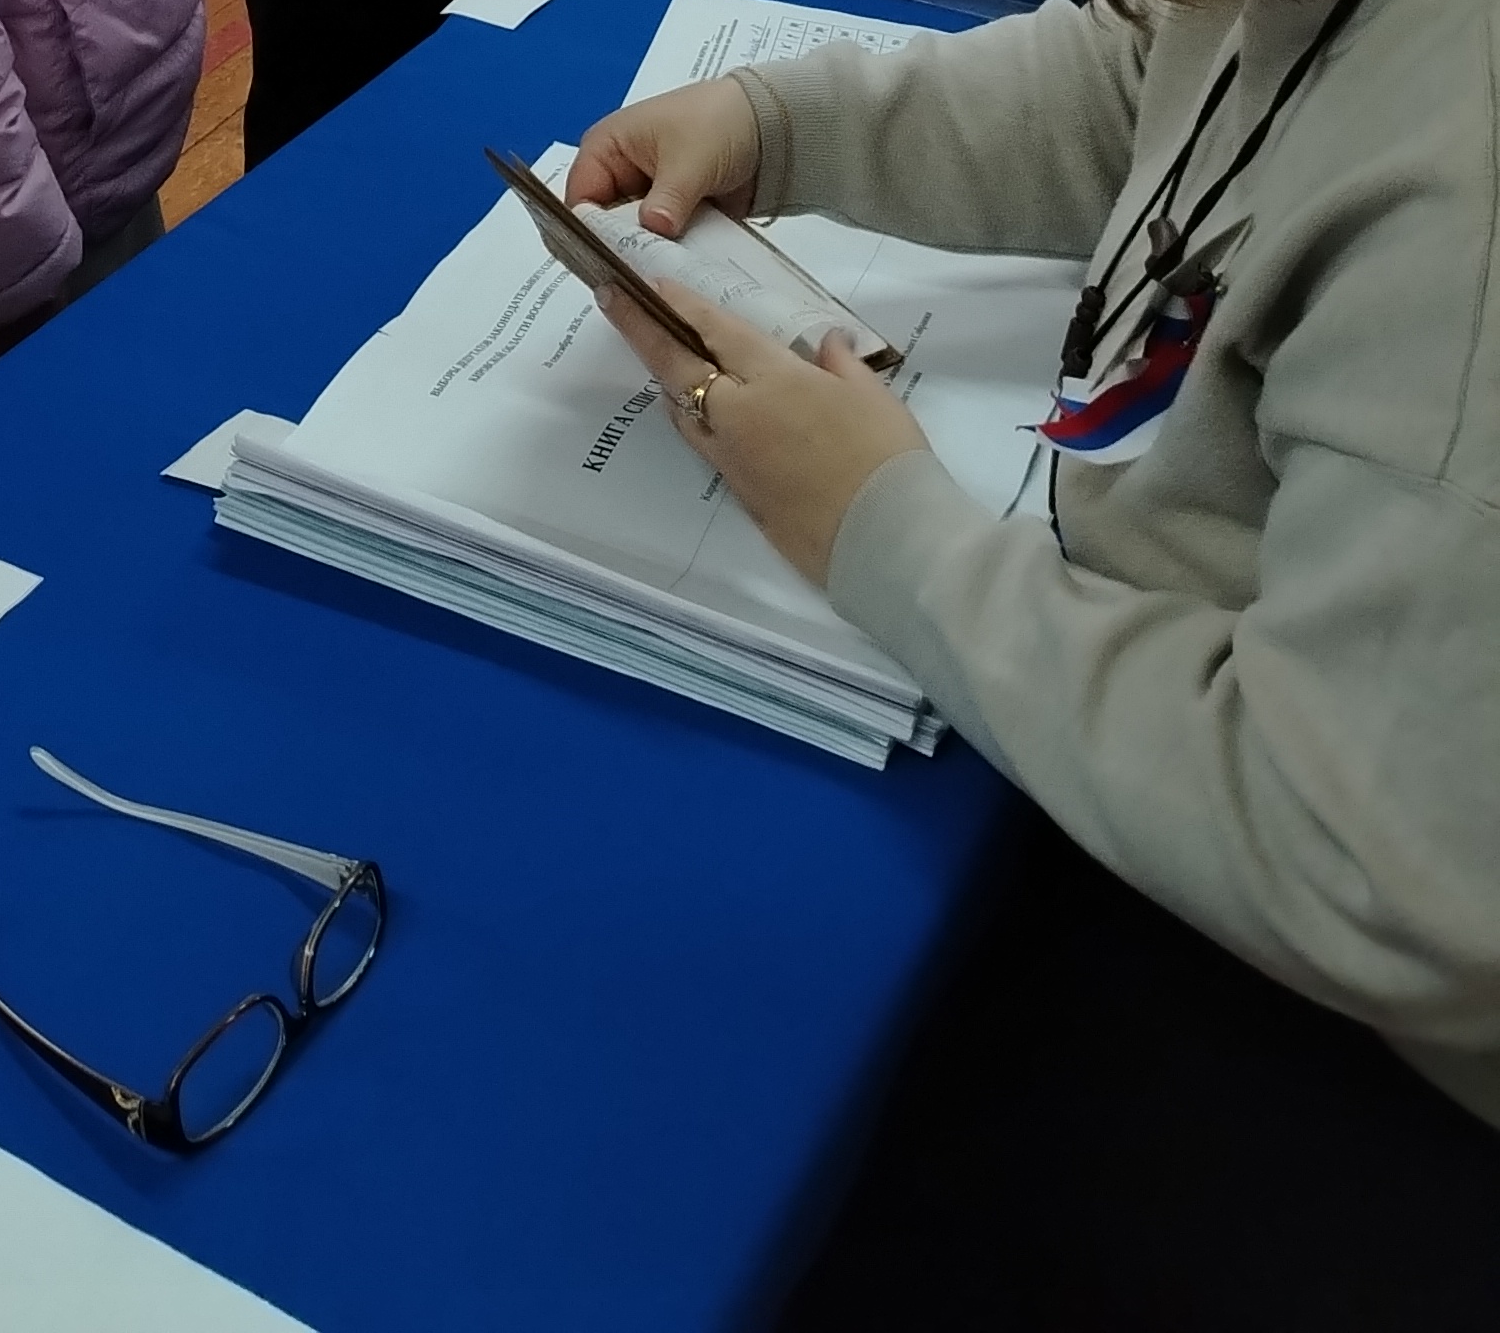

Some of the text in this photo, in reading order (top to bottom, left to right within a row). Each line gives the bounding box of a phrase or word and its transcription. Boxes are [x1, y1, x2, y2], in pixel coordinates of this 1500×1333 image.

[430, 366, 461, 397] ВЫБОРЫ
[486, 269, 546, 340] ЗАКОНОДАТЕЛЬНОГО
[468, 351, 507, 382] КИРОВСКОЙ
[501, 321, 532, 353] ОБЛАСТИ
[525, 282, 559, 321] ВОСЬМОГО
[582, 379, 664, 473] КНИГА СПИС
